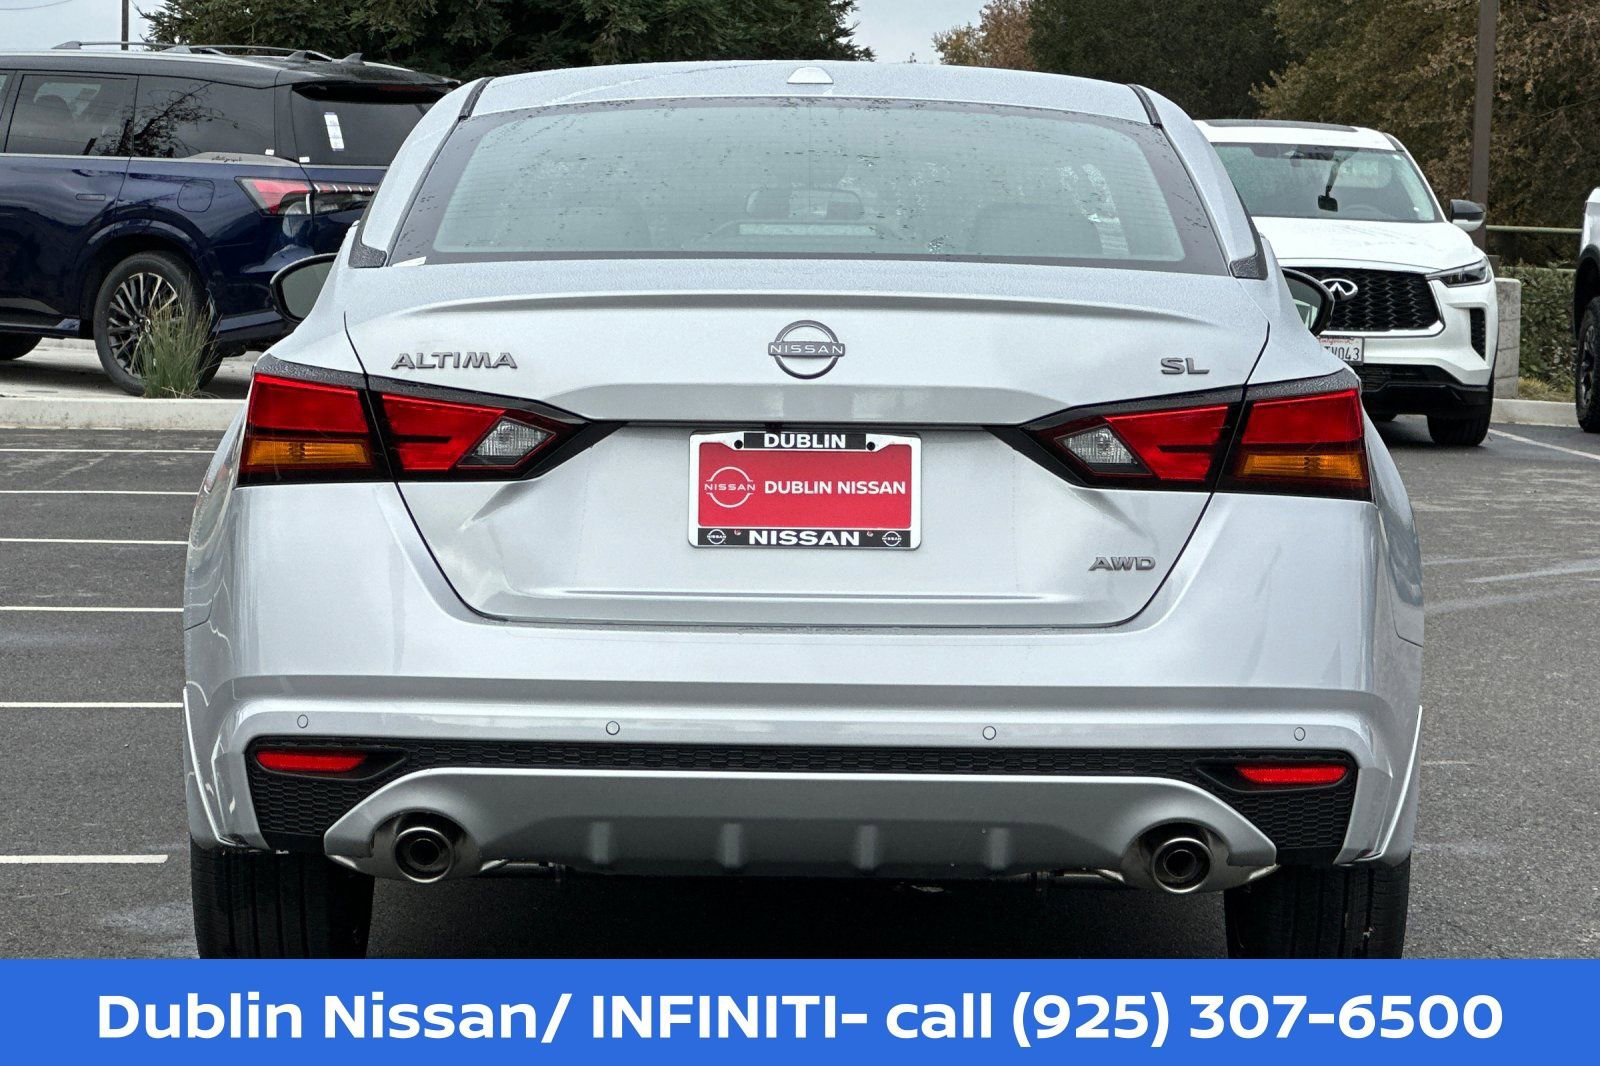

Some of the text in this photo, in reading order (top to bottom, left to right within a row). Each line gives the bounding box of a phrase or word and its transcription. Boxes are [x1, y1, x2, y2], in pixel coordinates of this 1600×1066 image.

[770, 345, 843, 354] NISSAN
[391, 351, 518, 369] ALTIMA
[1161, 357, 1210, 375] SL
[764, 433, 846, 449] DUBLIN
[704, 483, 756, 491] NISSAN
[764, 480, 906, 495] DUBLIN NISSAN
[749, 530, 860, 546] NISSAN
[1089, 556, 1156, 572] AWD
